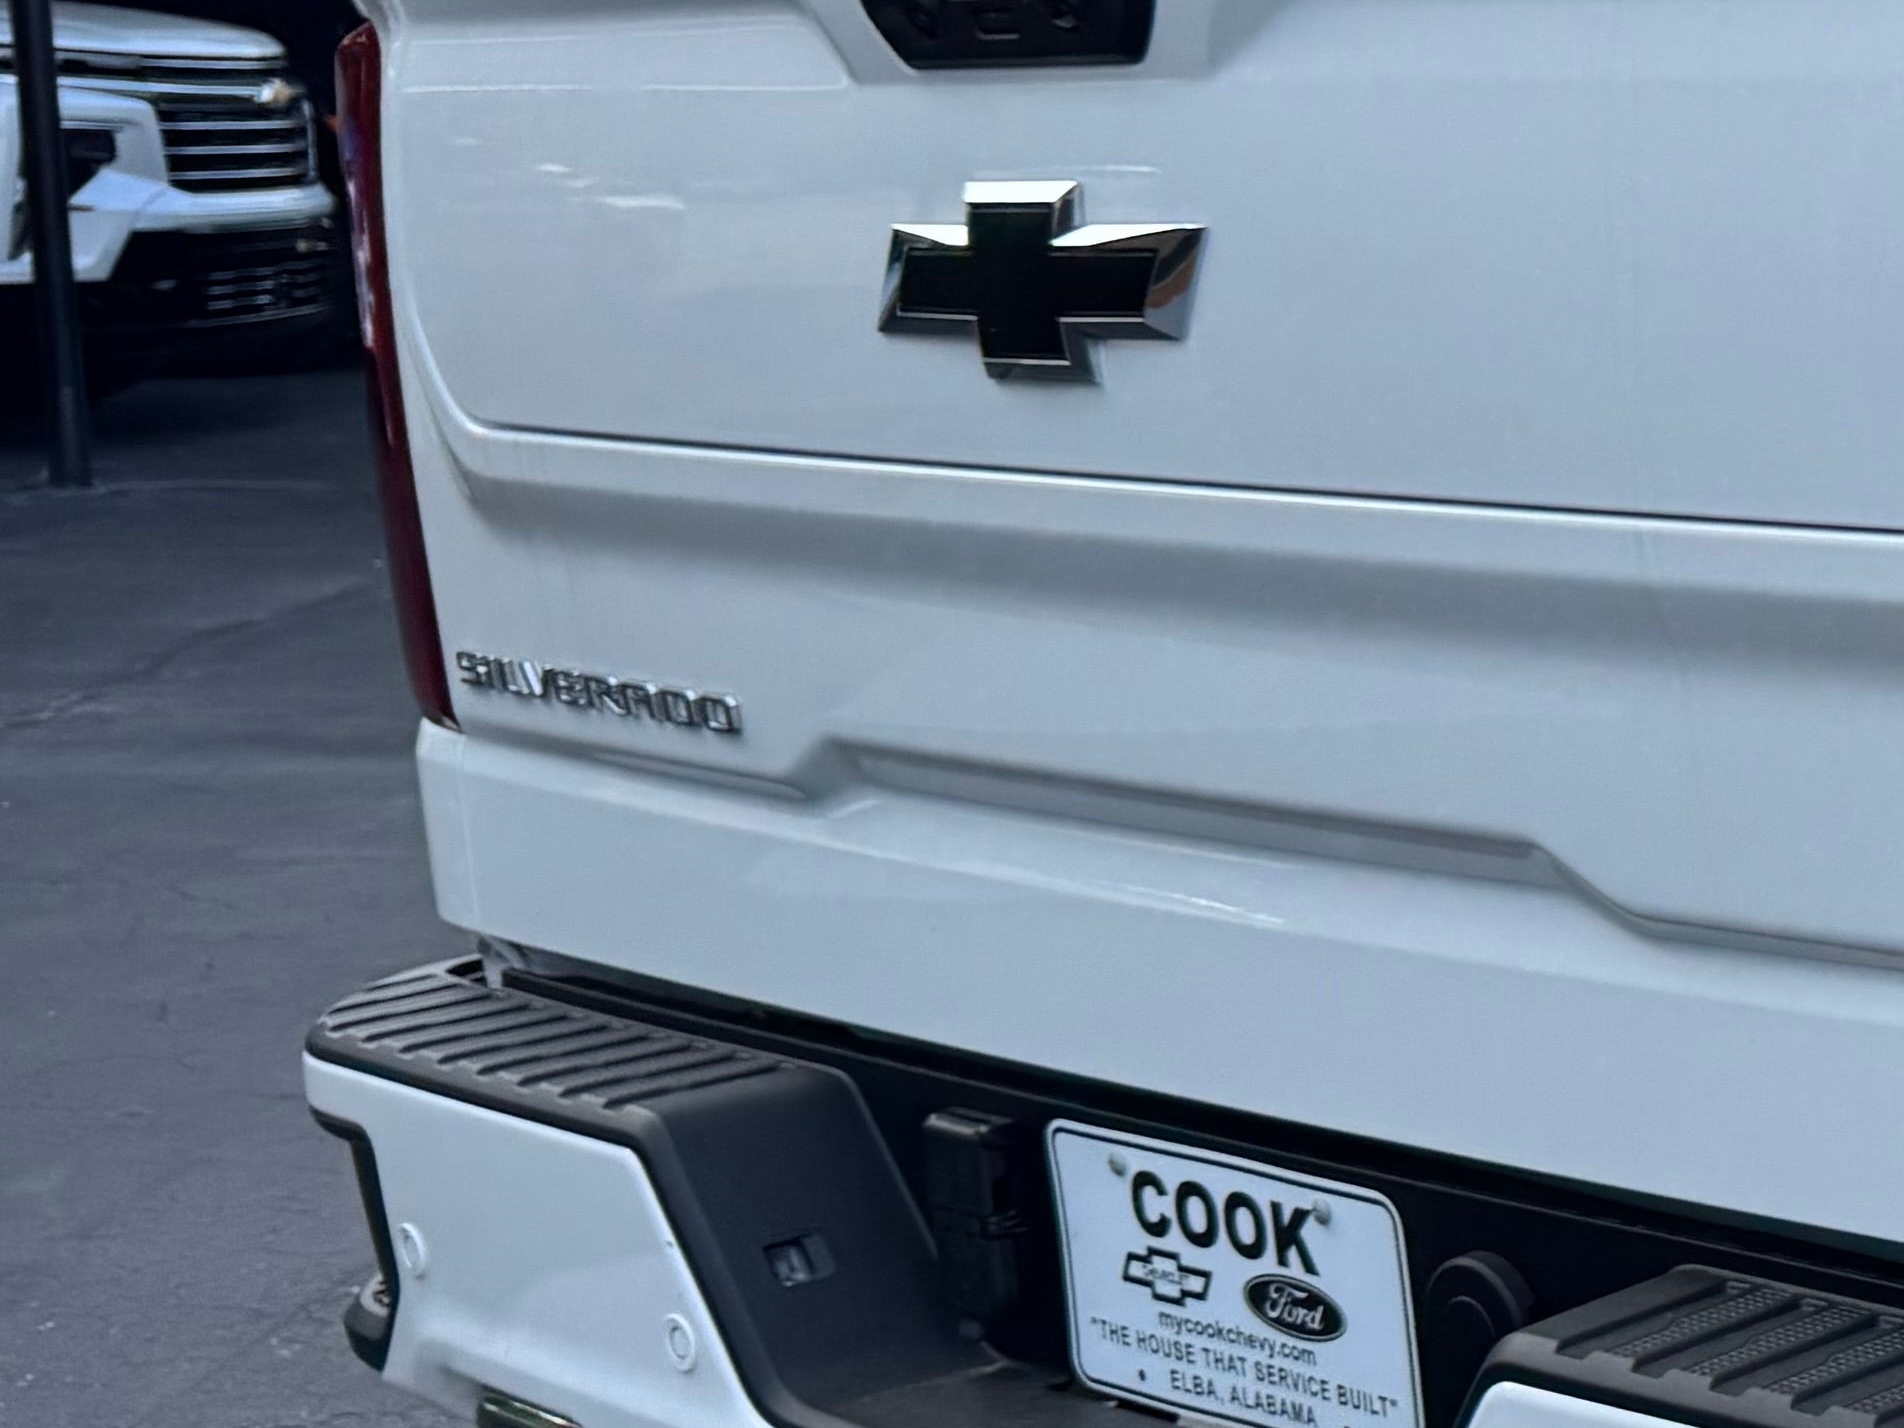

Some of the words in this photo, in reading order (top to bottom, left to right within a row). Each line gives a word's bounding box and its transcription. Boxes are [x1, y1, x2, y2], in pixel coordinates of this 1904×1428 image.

[456, 650, 743, 734] SILVERADO
[1131, 1170, 1321, 1276] COOK
[1158, 1311, 1317, 1366] mycookchevy.com
[1265, 1283, 1324, 1330] Ford
[1136, 1329, 1196, 1365] HOUSE
[1202, 1346, 1248, 1376] THAT
[1253, 1360, 1331, 1402] SERVICE
[1169, 1368, 1225, 1406] ELBA,
[1229, 1385, 1319, 1428] ALABAMA
